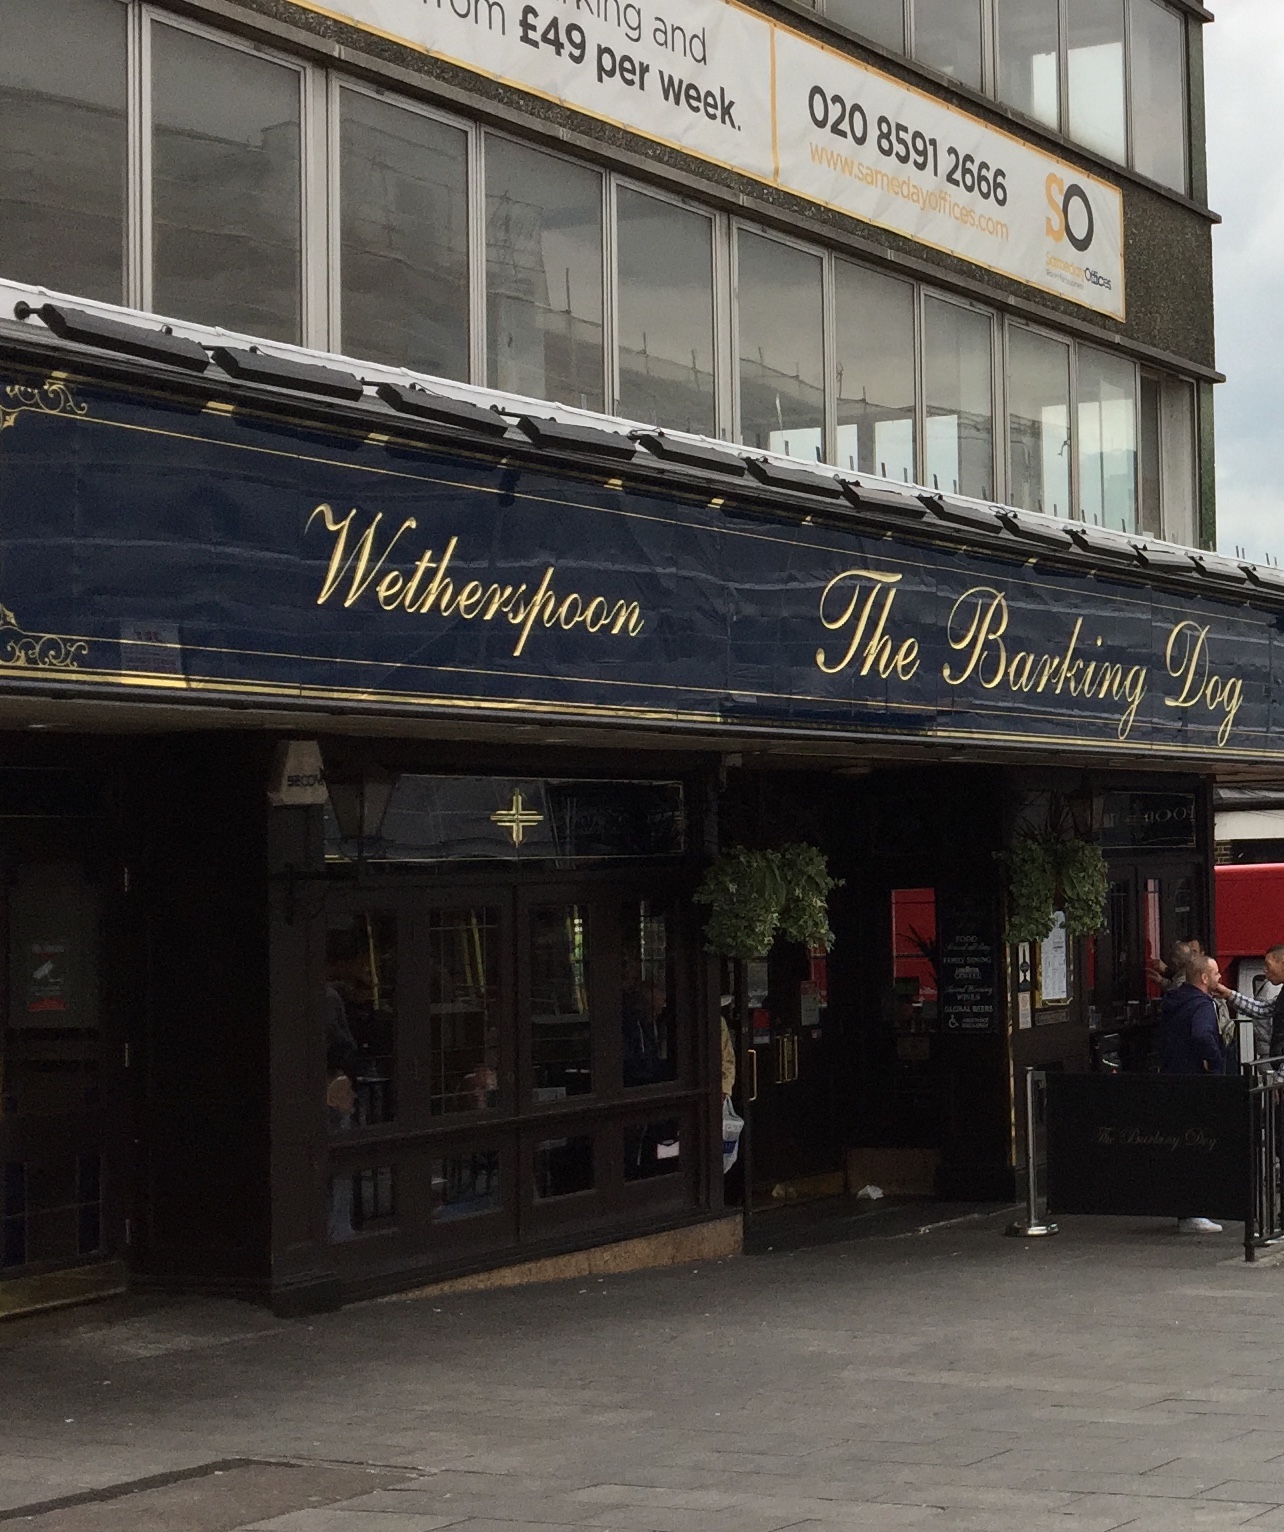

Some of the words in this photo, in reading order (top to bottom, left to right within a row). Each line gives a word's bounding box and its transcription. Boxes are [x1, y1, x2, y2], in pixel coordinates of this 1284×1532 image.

[518, 4, 587, 65] £49
[596, 43, 650, 92] per
[658, 68, 742, 132] week.
[653, 16, 708, 66] and
[808, 85, 868, 146] 020
[876, 115, 939, 177] 8591
[946, 145, 1008, 207] 2666
[809, 142, 1009, 242] www.samedayoffices.com
[1045, 172, 1095, 252] SO
[305, 503, 645, 657] Wetherspoon
[815, 569, 920, 681] The
[943, 587, 1148, 741] Barking
[1164, 621, 1244, 747] Dog
